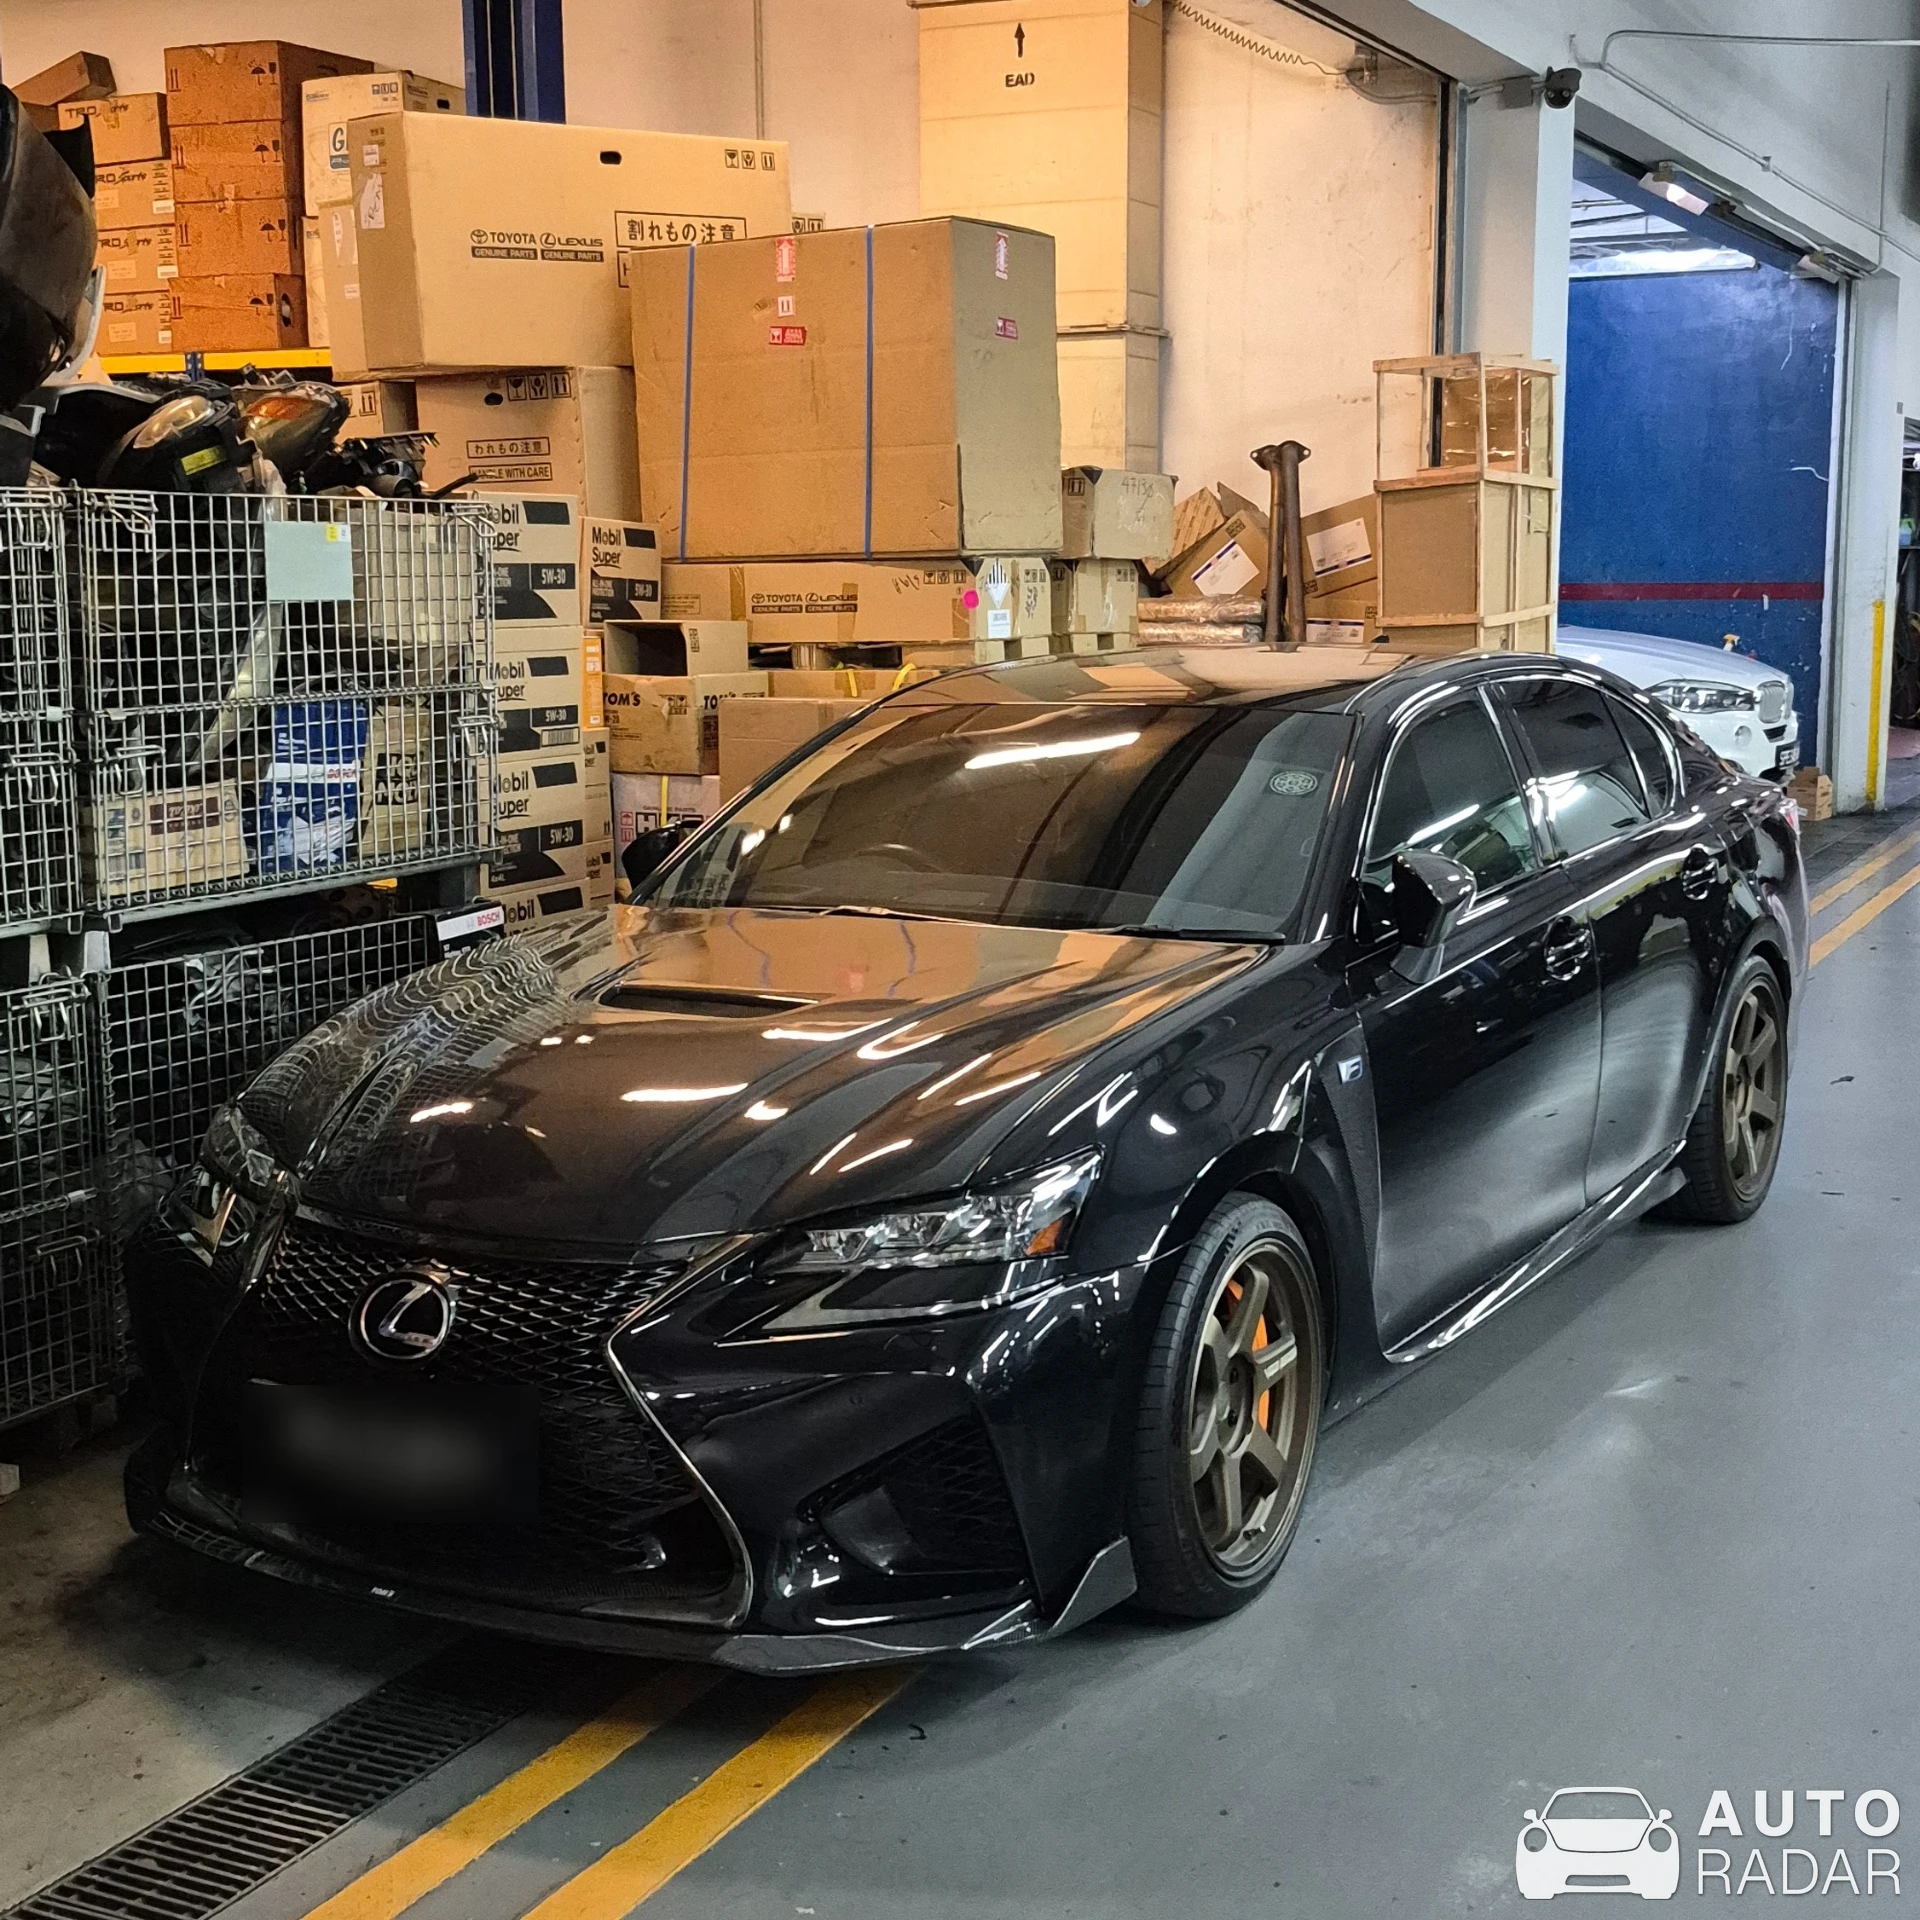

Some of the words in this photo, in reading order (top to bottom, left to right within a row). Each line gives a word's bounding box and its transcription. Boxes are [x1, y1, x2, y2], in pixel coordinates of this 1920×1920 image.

[489, 231, 537, 245] TOYOTA
[557, 237, 603, 247] LEXUS
[474, 248, 508, 258] GENUINE
[509, 250, 535, 259] PARTS
[543, 251, 576, 260] GENUINE
[577, 252, 602, 261] PARTS
[505, 467, 526, 479] WITH
[526, 466, 550, 478] CARE
[591, 526, 622, 547] Mobil
[591, 546, 621, 566] Super
[541, 567, 567, 585] 5W-30
[766, 594, 803, 603] TOYOTA
[819, 594, 858, 602] LEXUS
[495, 684, 526, 701] uper
[545, 708, 568, 722] 5W-30
[550, 826, 574, 845] 5W-30
[476, 911, 501, 927] BOSCH
